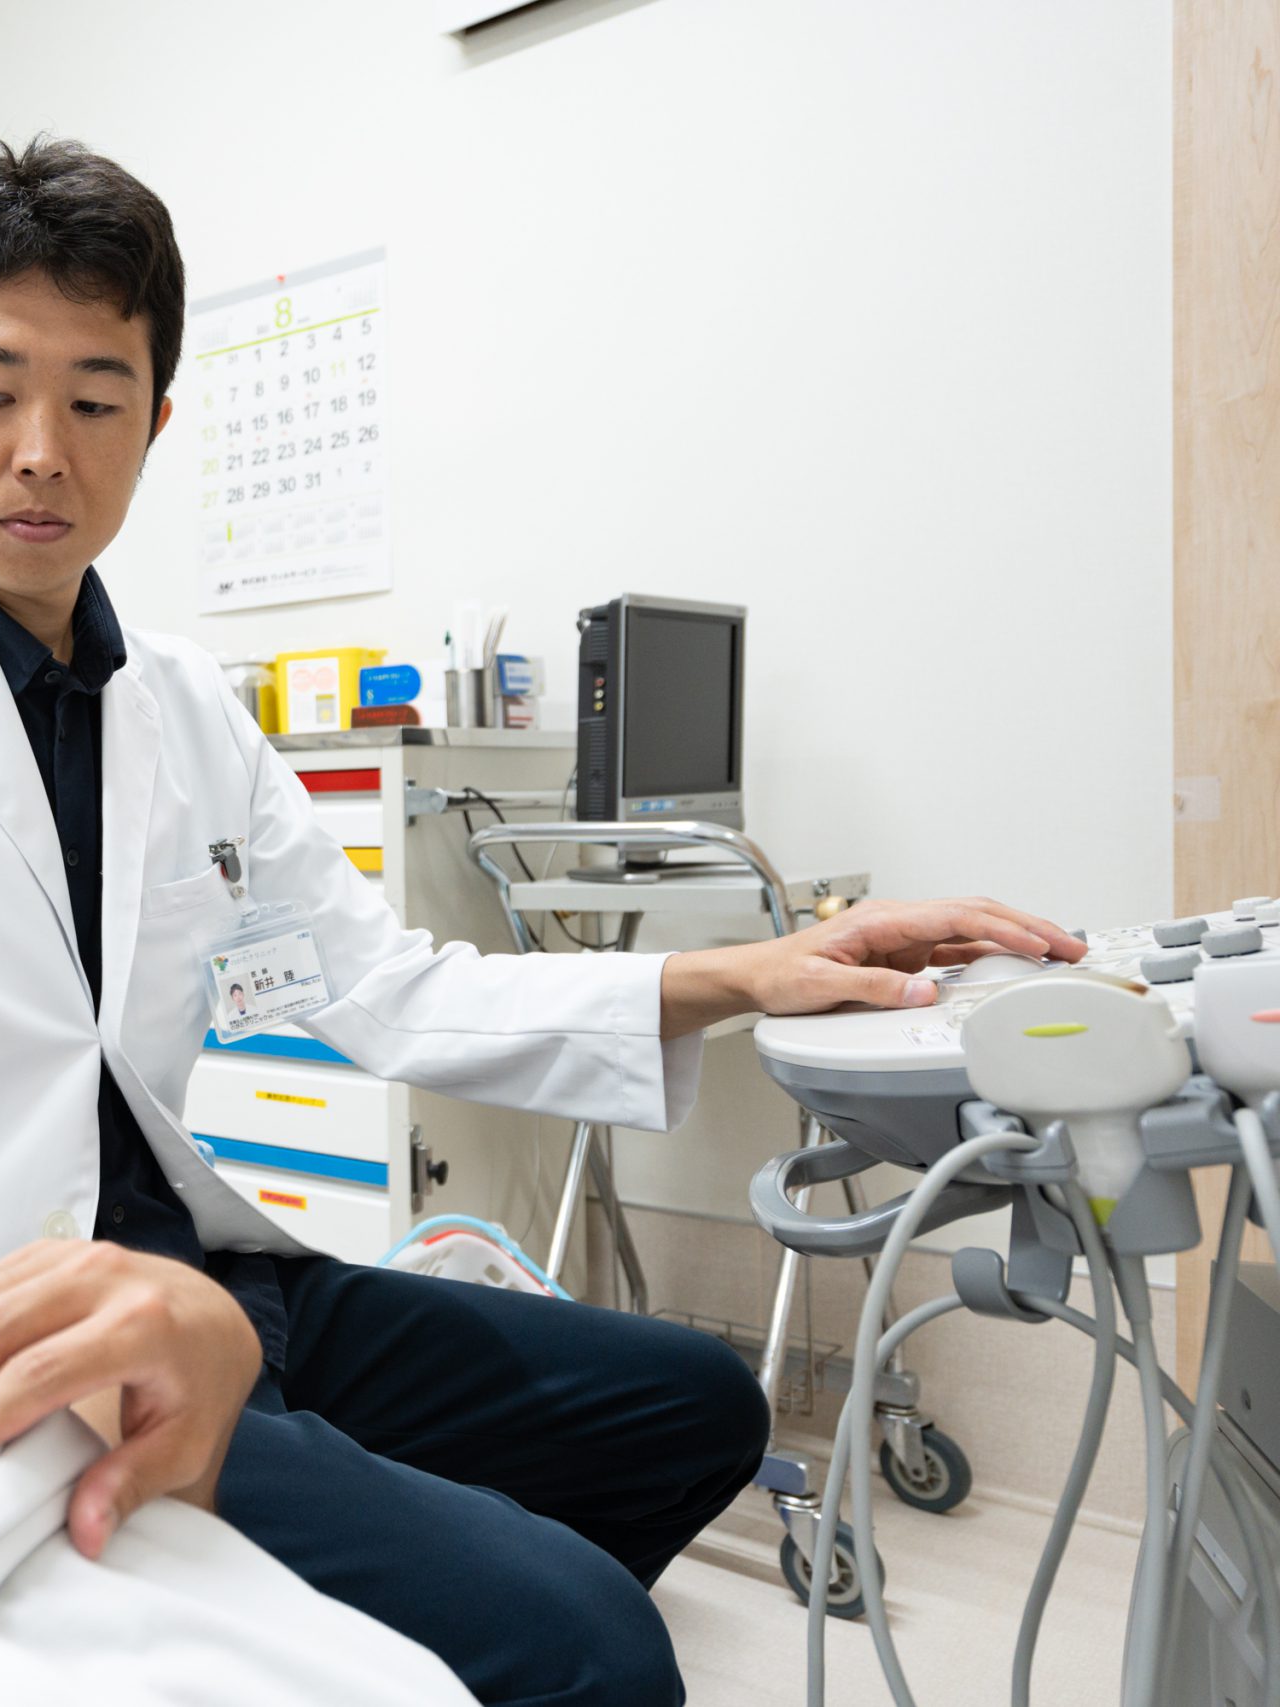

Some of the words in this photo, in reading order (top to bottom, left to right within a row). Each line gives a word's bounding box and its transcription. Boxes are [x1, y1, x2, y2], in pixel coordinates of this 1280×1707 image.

[274, 296, 292, 329] 8
[255, 349, 262, 362] 1
[280, 341, 289, 357] 2
[307, 334, 316, 349] 3
[333, 326, 342, 341] 4
[361, 319, 372, 335] 5
[203, 393, 213, 409] 6
[229, 387, 238, 402] 7
[255, 381, 264, 396] 8
[280, 375, 290, 390] 9
[303, 368, 320, 384] 10
[330, 360, 346, 378] 11
[357, 354, 376, 371] 12
[226, 420, 242, 437] 14
[252, 414, 268, 431] 15
[277, 408, 294, 425] 16
[304, 402, 320, 418] 17
[331, 396, 347, 412] 18
[358, 389, 376, 407] 19
[201, 458, 220, 476] 20
[227, 454, 243, 471] 21
[251, 447, 270, 466] 22
[277, 441, 296, 461] 23
[304, 437, 322, 455] 24
[330, 430, 350, 450] 25
[358, 424, 379, 444] 26
[201, 491, 220, 509] 27
[226, 487, 245, 504] 28
[252, 481, 271, 500] 29
[278, 476, 297, 495] 30
[304, 472, 321, 490] 31
[337, 467, 342, 478] 1
[364, 461, 372, 473] 2
[254, 976, 275, 991] 新井
[284, 970, 296, 983] 陸
